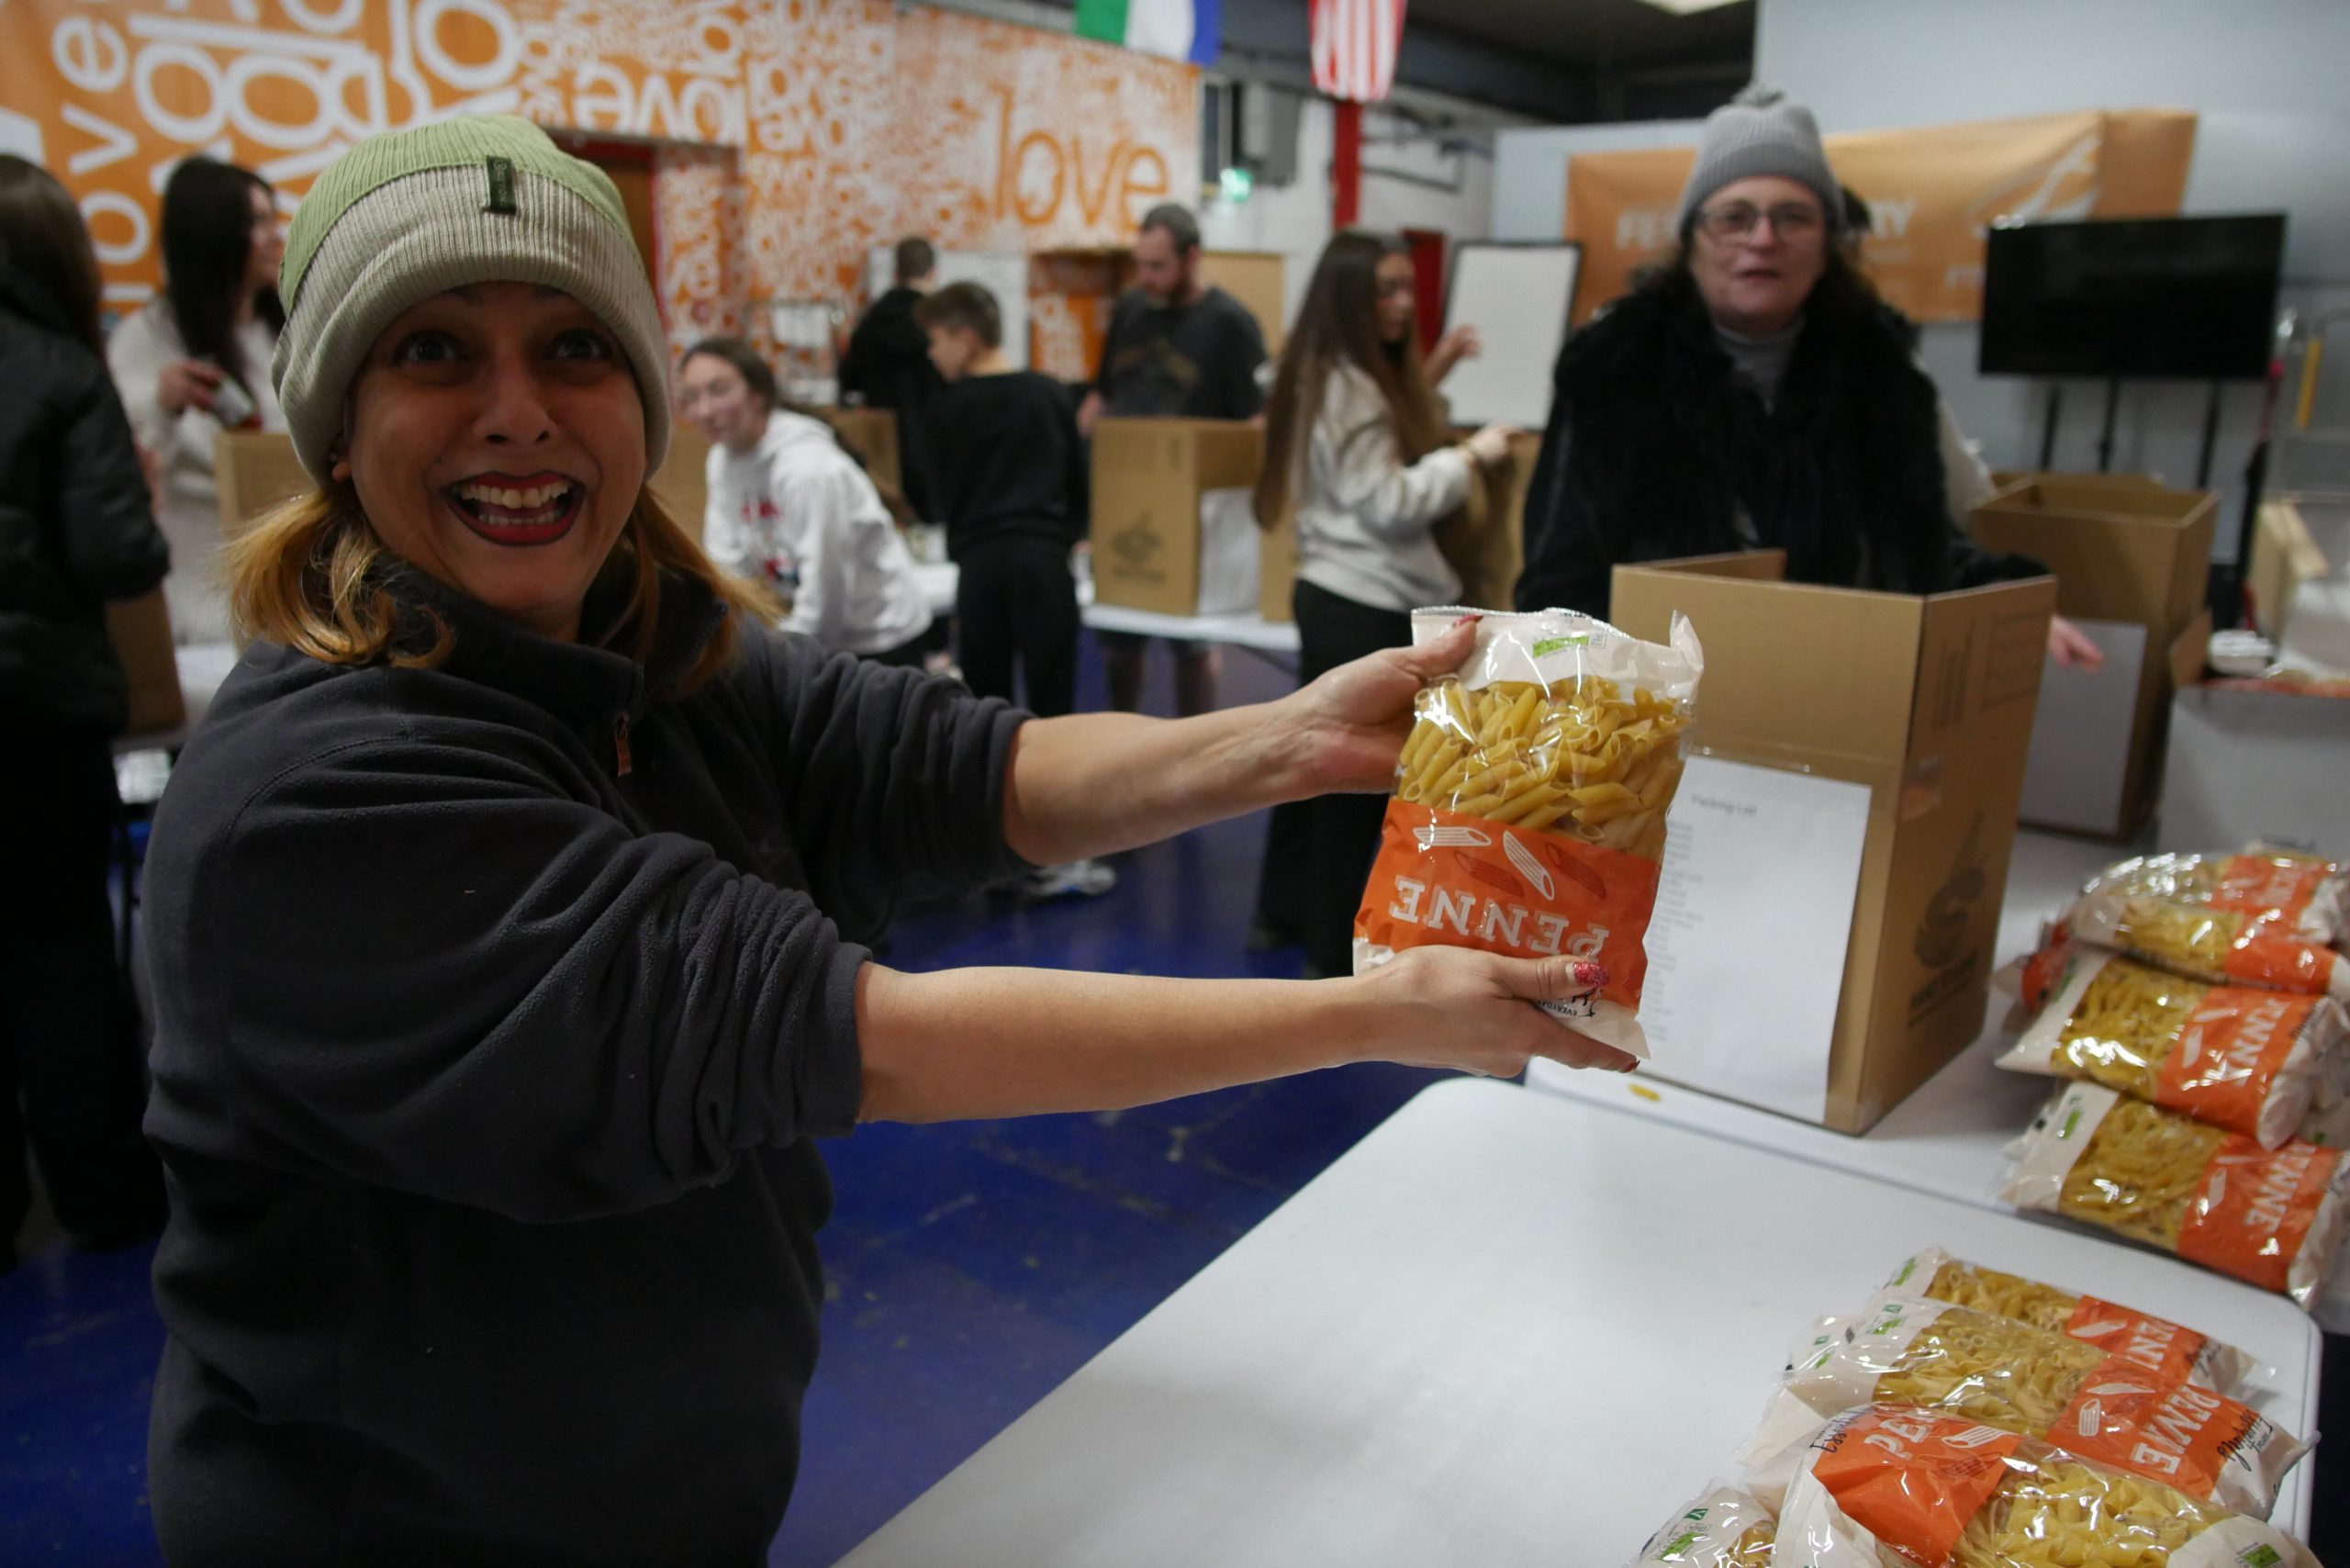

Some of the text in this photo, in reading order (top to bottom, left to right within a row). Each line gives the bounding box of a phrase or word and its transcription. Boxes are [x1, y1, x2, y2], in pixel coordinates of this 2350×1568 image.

[990, 81, 1169, 231] love
[1390, 876, 1610, 960] PENNE
[1537, 999, 1579, 1018] EVERYDA
